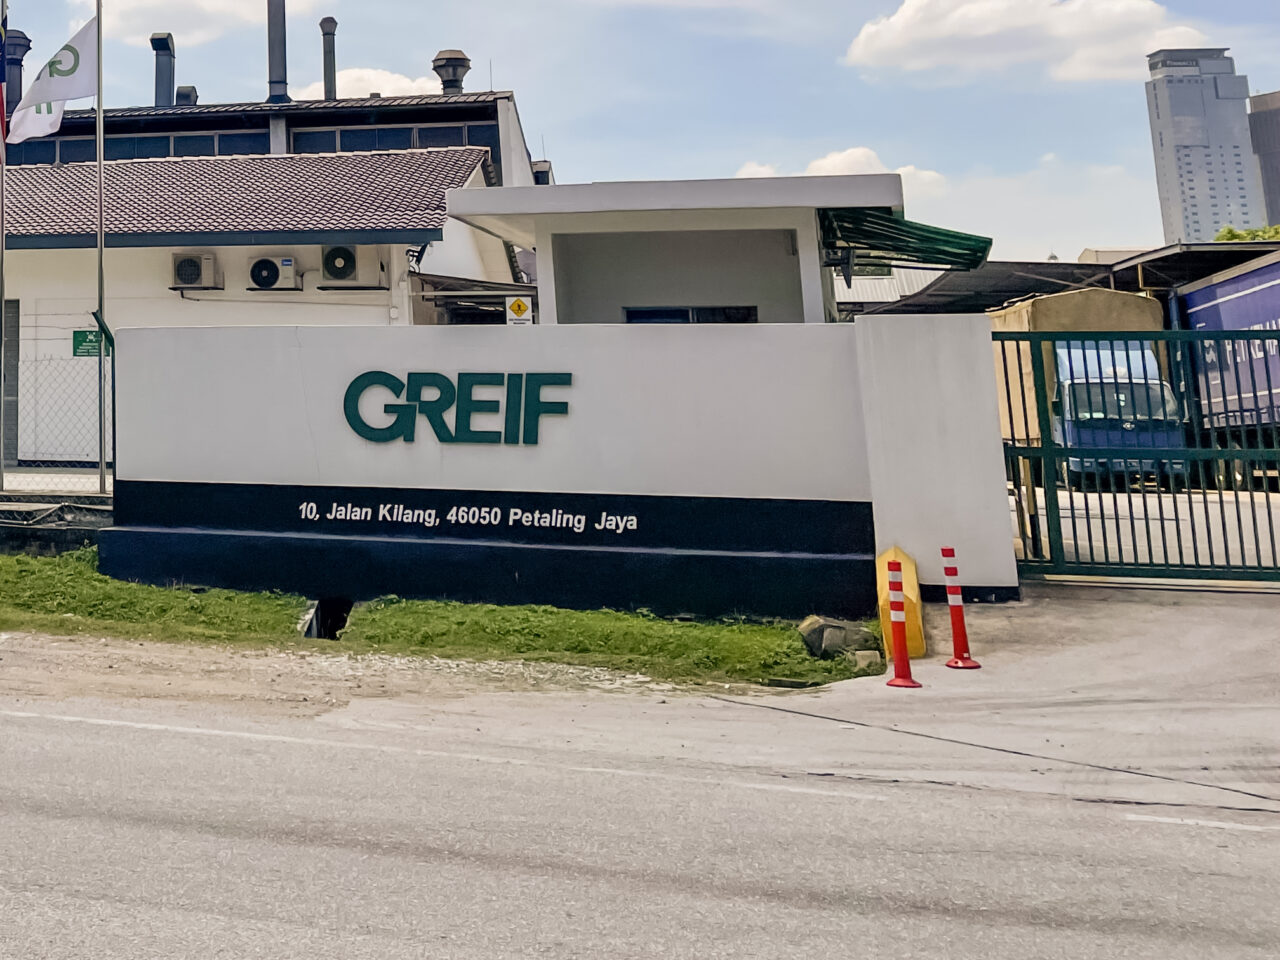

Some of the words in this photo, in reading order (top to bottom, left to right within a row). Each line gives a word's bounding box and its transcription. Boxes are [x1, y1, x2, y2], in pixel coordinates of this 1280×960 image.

[343, 371, 573, 445] GREIF
[298, 502, 320, 521] 10,
[326, 502, 372, 521] Jalan
[378, 504, 440, 527] Kilang,
[446, 506, 501, 526] 46050
[508, 508, 586, 533] Petaling
[594, 511, 638, 534] Jaya
